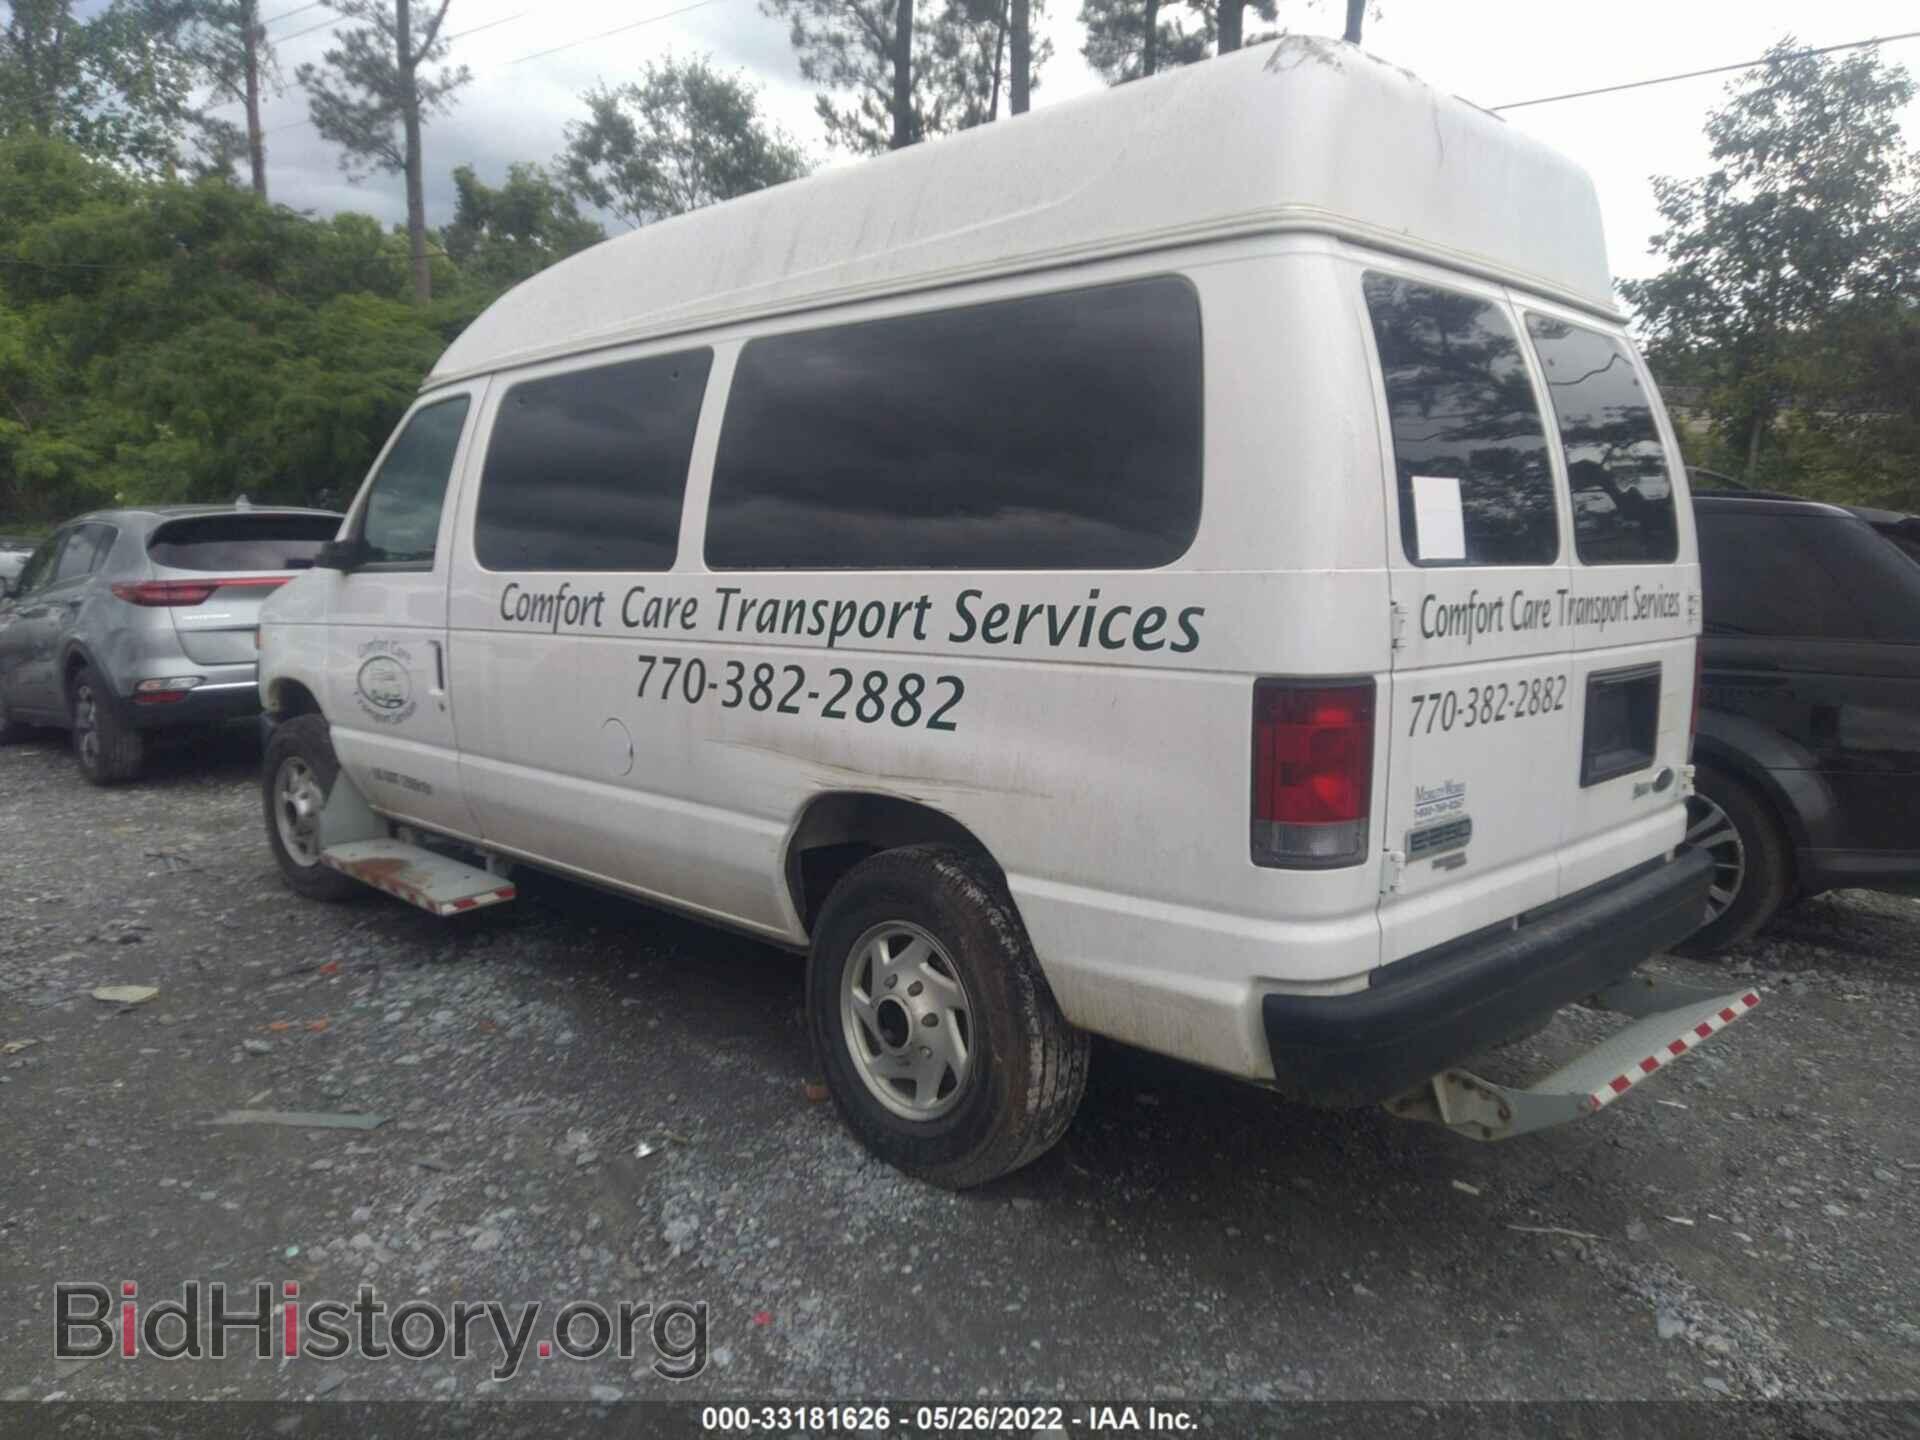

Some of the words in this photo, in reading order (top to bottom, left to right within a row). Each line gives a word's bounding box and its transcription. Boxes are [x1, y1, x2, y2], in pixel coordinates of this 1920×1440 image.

[500, 582, 605, 634] Comfort
[621, 586, 698, 631] Care
[715, 587, 932, 648] Transport
[948, 588, 1206, 653] Services
[1421, 590, 1504, 644] Comfort
[1510, 590, 1551, 631] Care
[1557, 589, 1629, 631] Transport
[1633, 584, 1681, 621] Services
[636, 655, 966, 732] 770-382-2882
[1408, 675, 1567, 737] 770-382-2882
